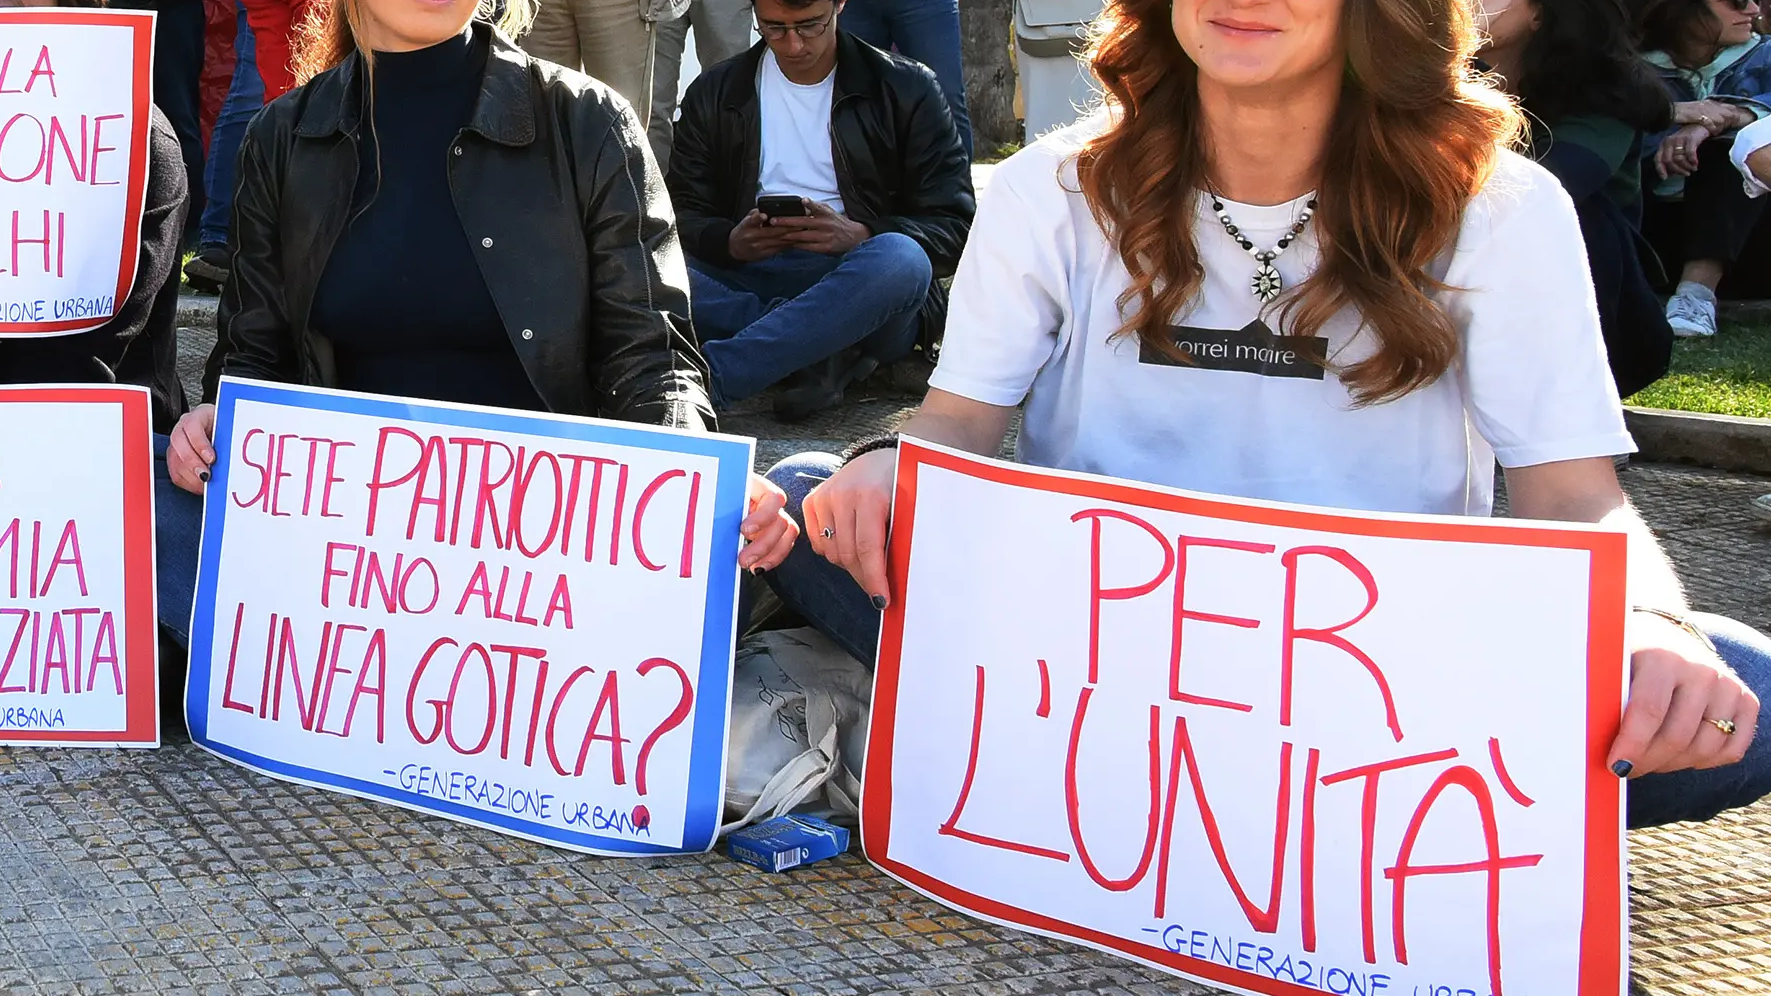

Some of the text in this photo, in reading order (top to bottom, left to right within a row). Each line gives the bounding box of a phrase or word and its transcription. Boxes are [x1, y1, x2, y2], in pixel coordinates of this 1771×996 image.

[54, 295, 114, 319] URBANA
[231, 426, 702, 579] SIETE PATRIOTTICI
[321, 541, 574, 630] FINO ALLA
[1070, 507, 1405, 744] PER
[222, 602, 694, 828] LINEA GOTICA?
[562, 800, 651, 838] URBANA
